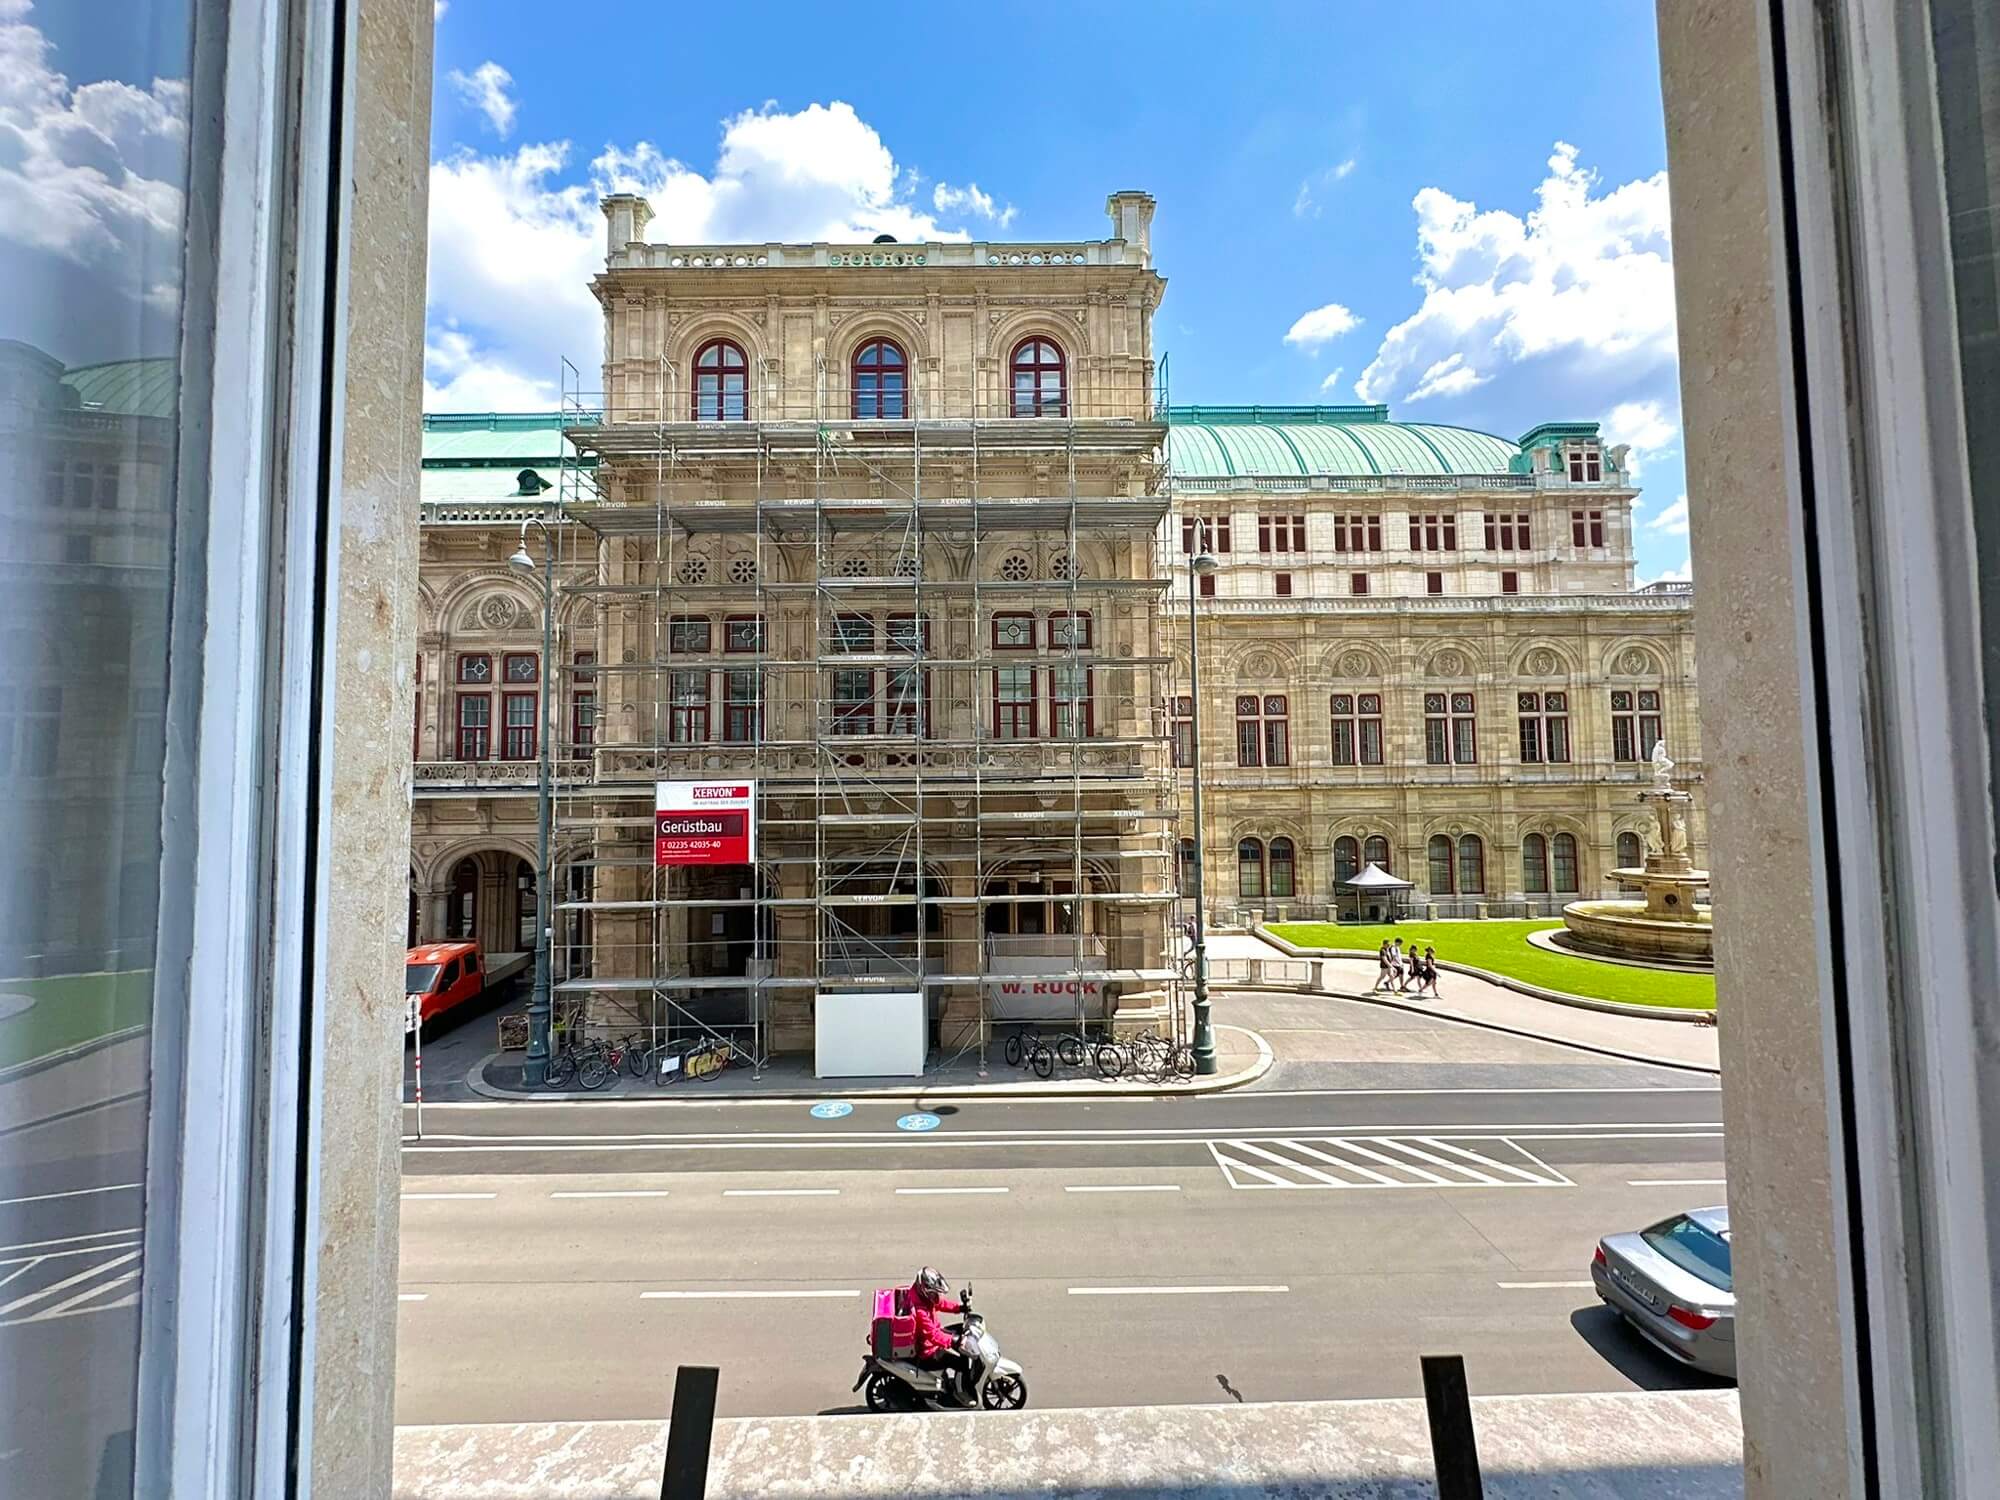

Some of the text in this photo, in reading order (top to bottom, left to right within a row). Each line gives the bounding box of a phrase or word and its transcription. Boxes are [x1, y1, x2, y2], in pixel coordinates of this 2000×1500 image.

[661, 819, 722, 833] Gerüstbau
[661, 840, 721, 849] T 02235 42035-40
[1001, 982, 1026, 994] W.
